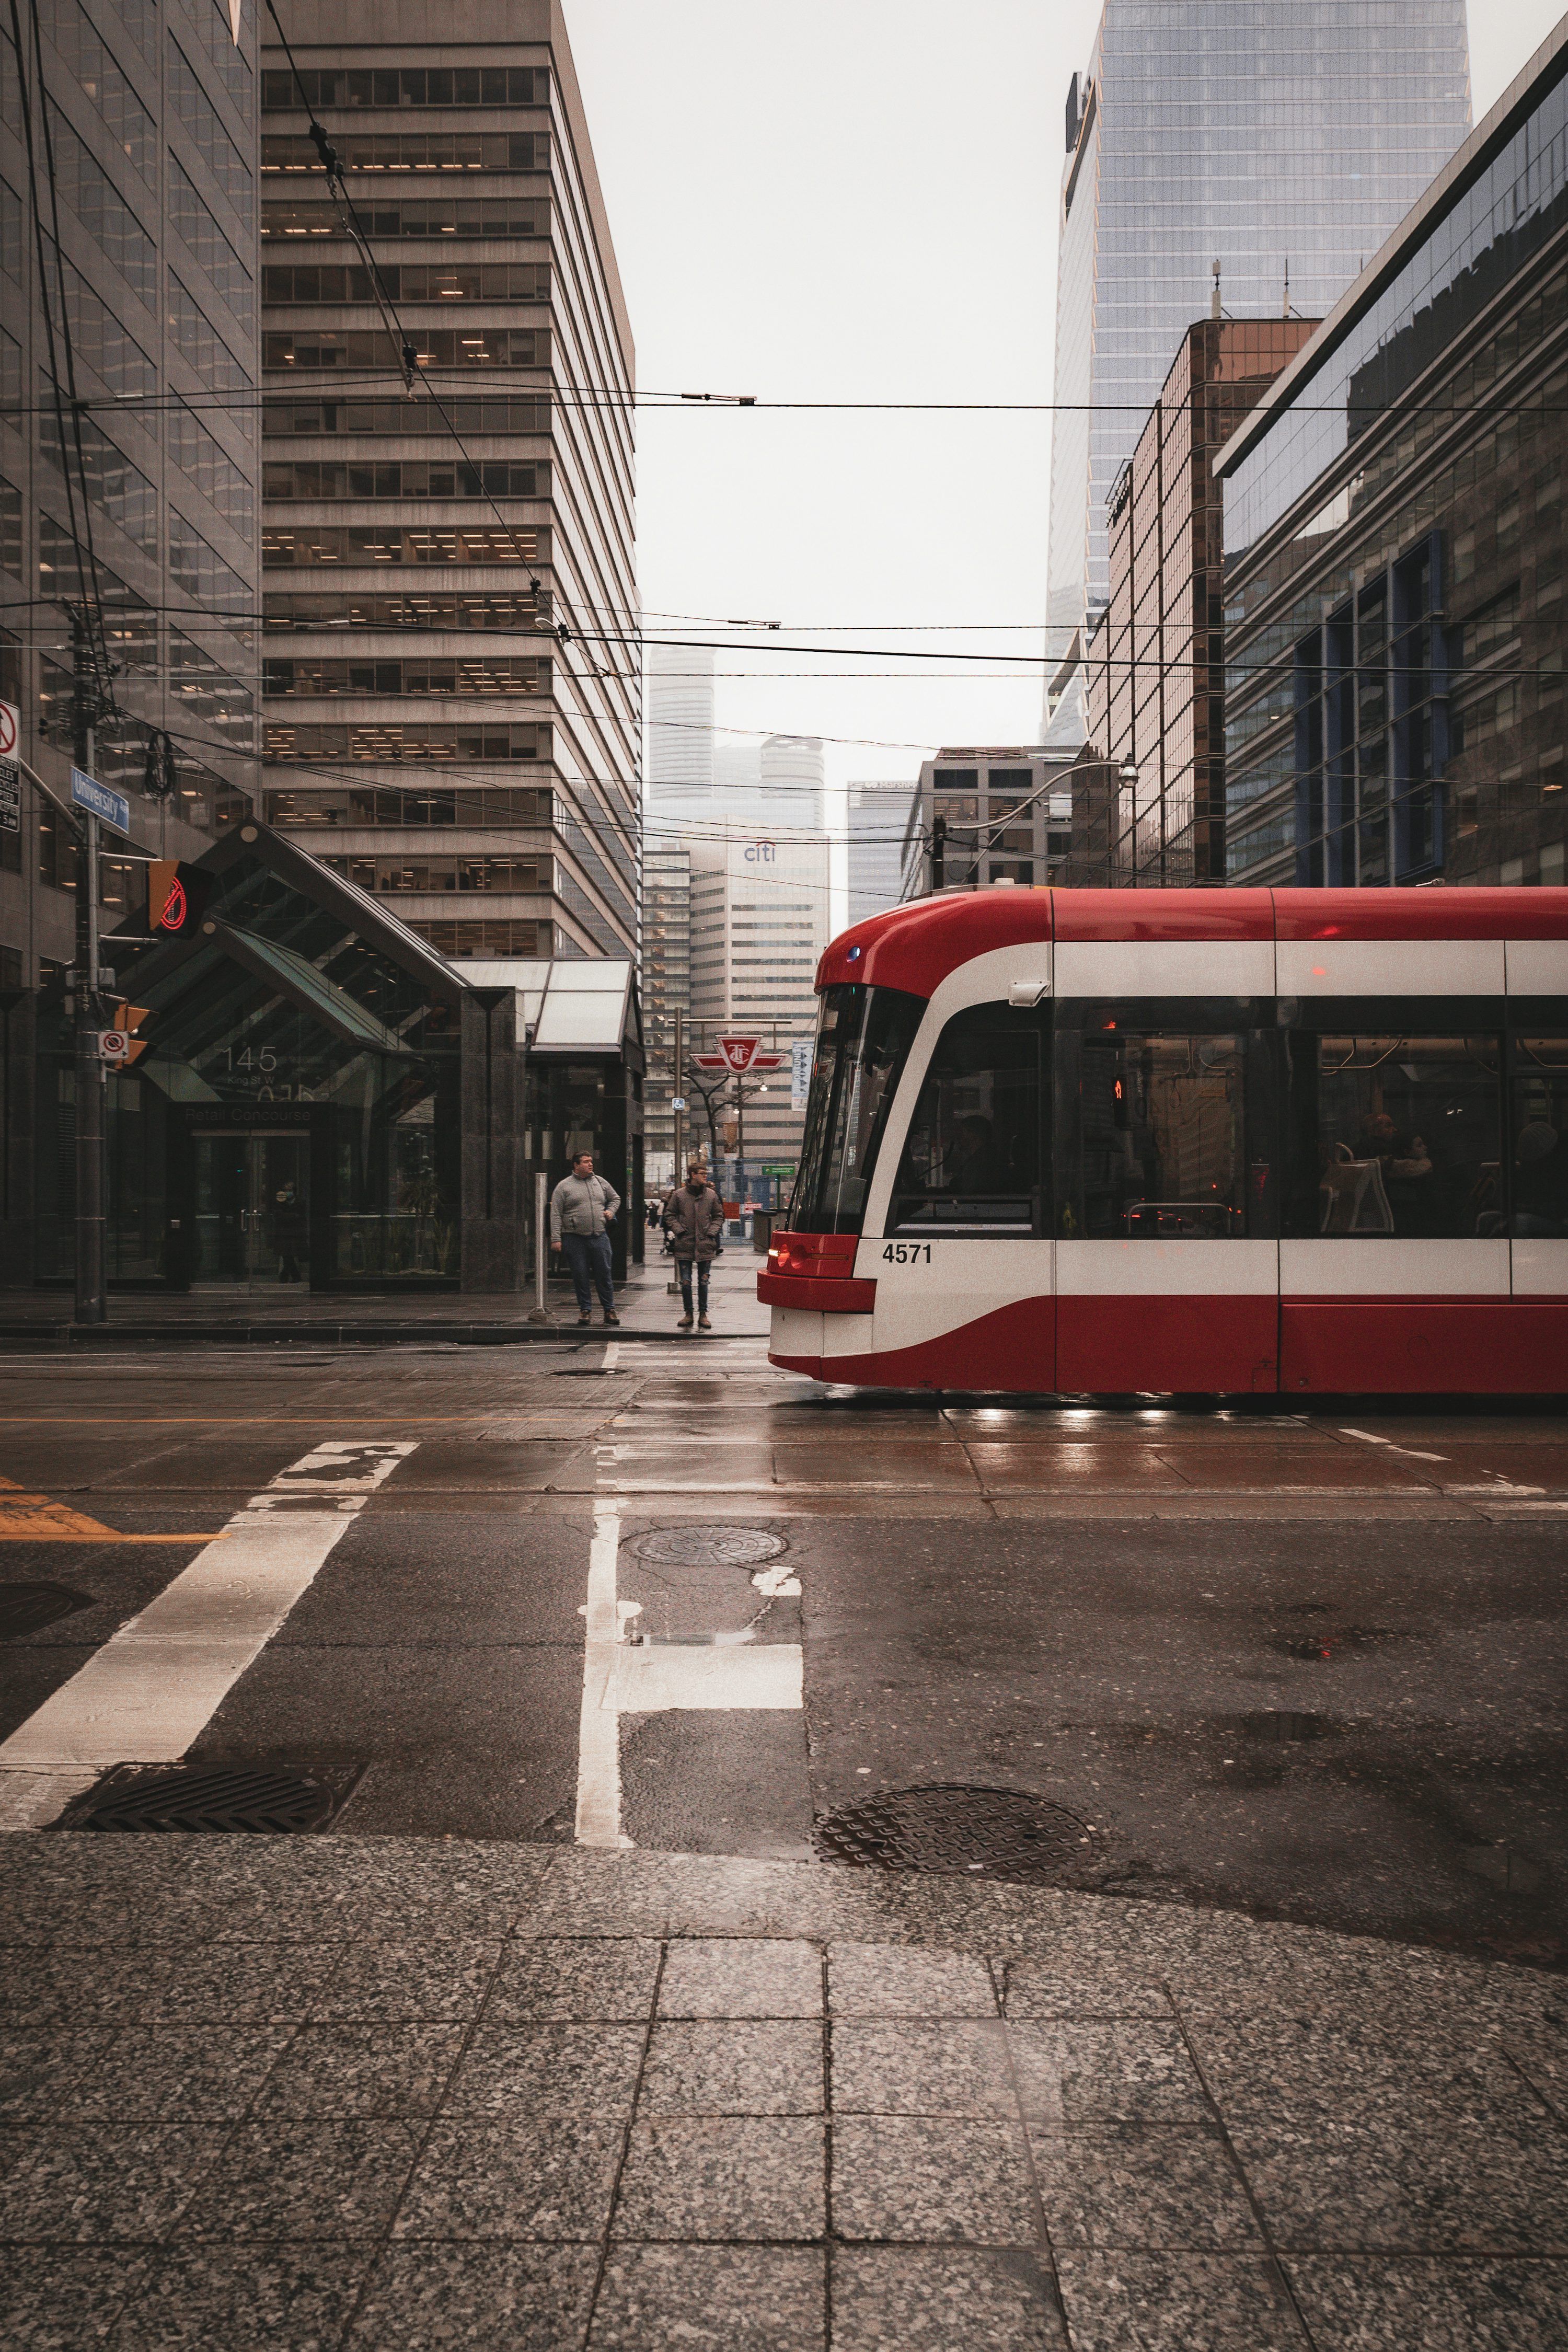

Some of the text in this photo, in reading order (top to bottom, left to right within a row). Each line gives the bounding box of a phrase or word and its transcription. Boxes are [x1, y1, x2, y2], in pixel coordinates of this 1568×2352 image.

[74, 771, 118, 821] University
[744, 844, 775, 861] citi
[222, 1046, 276, 1071] 145
[228, 1076, 248, 1086] King
[185, 1109, 310, 1121] Retail Concourse
[882, 1243, 931, 1263] 4571
[898, 1827, 1007, 1854] DANGER
